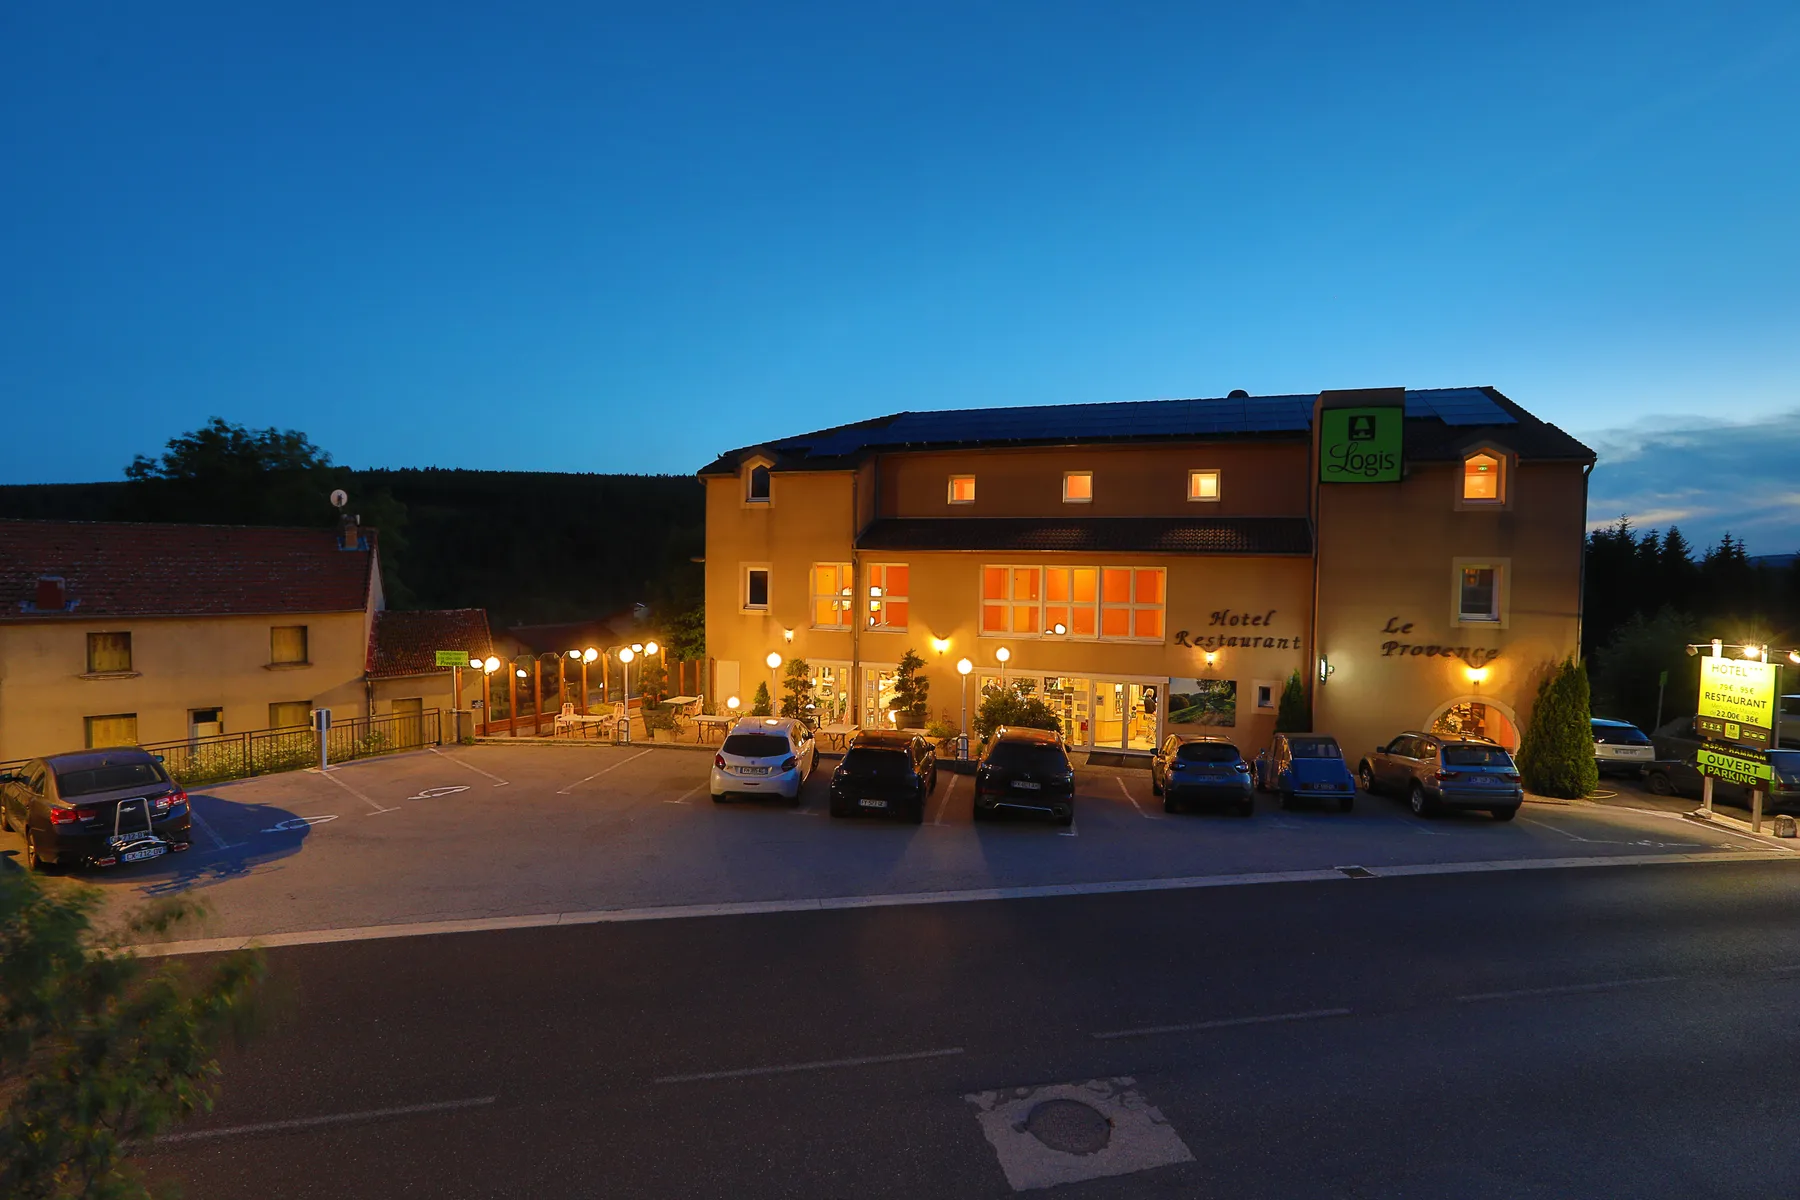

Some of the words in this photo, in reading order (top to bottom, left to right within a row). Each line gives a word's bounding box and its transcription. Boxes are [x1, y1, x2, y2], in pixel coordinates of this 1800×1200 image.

[1327, 442, 1395, 477] Logis
[1209, 609, 1277, 626] Hotel
[1382, 616, 1414, 633] Le
[1174, 630, 1302, 650] Restaurant
[1382, 641, 1499, 660] Provence
[1711, 664, 1748, 677] HOTEL
[1704, 691, 1767, 709] RESTAURANT
[1745, 715, 1759, 724] 36€
[1707, 754, 1760, 775] OUVERT
[1707, 766, 1757, 785] PARKING
